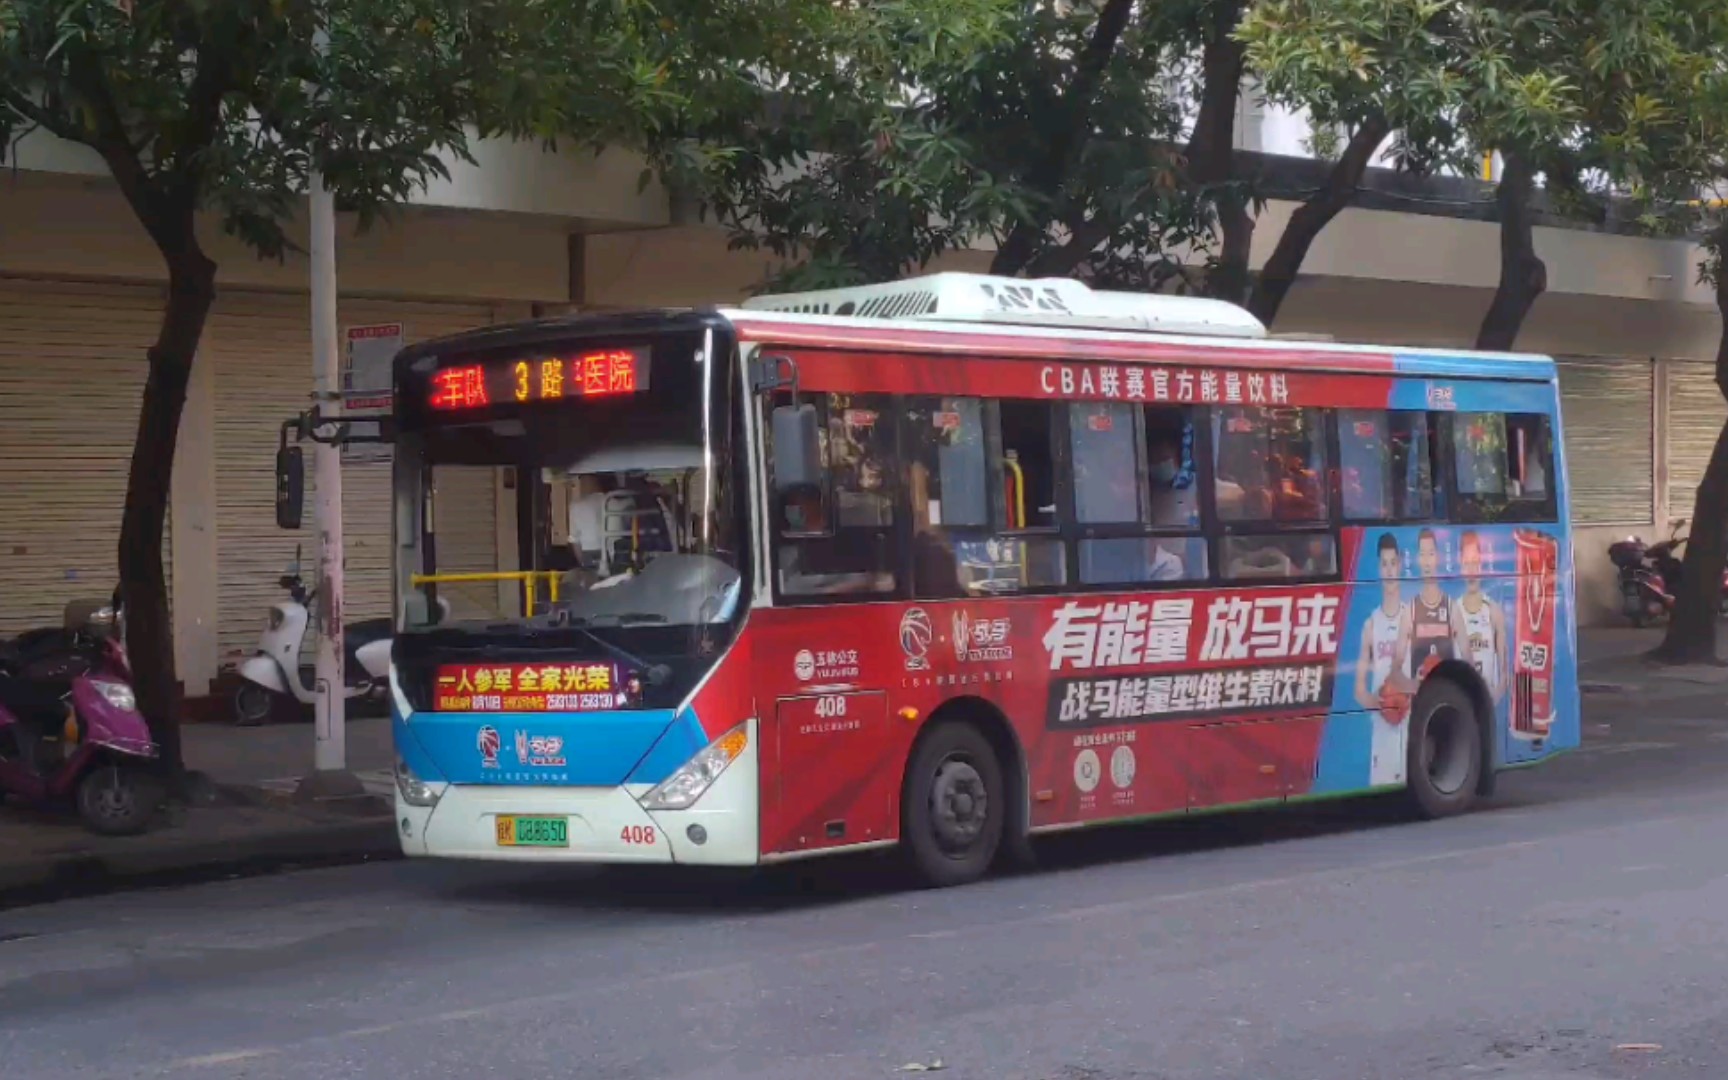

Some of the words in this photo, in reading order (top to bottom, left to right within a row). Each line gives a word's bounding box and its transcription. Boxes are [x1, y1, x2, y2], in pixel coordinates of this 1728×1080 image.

[1041, 366, 1289, 404] CBA联赛官方能量饮料
[1042, 597, 1194, 671] 有能量
[1199, 592, 1340, 661] 放马来
[438, 668, 512, 693] 一人参军
[517, 665, 611, 692] 全家光荣
[1059, 666, 1323, 723] 战马能量型维生素饮料
[814, 695, 847, 718] 408
[620, 825, 656, 845] 408
